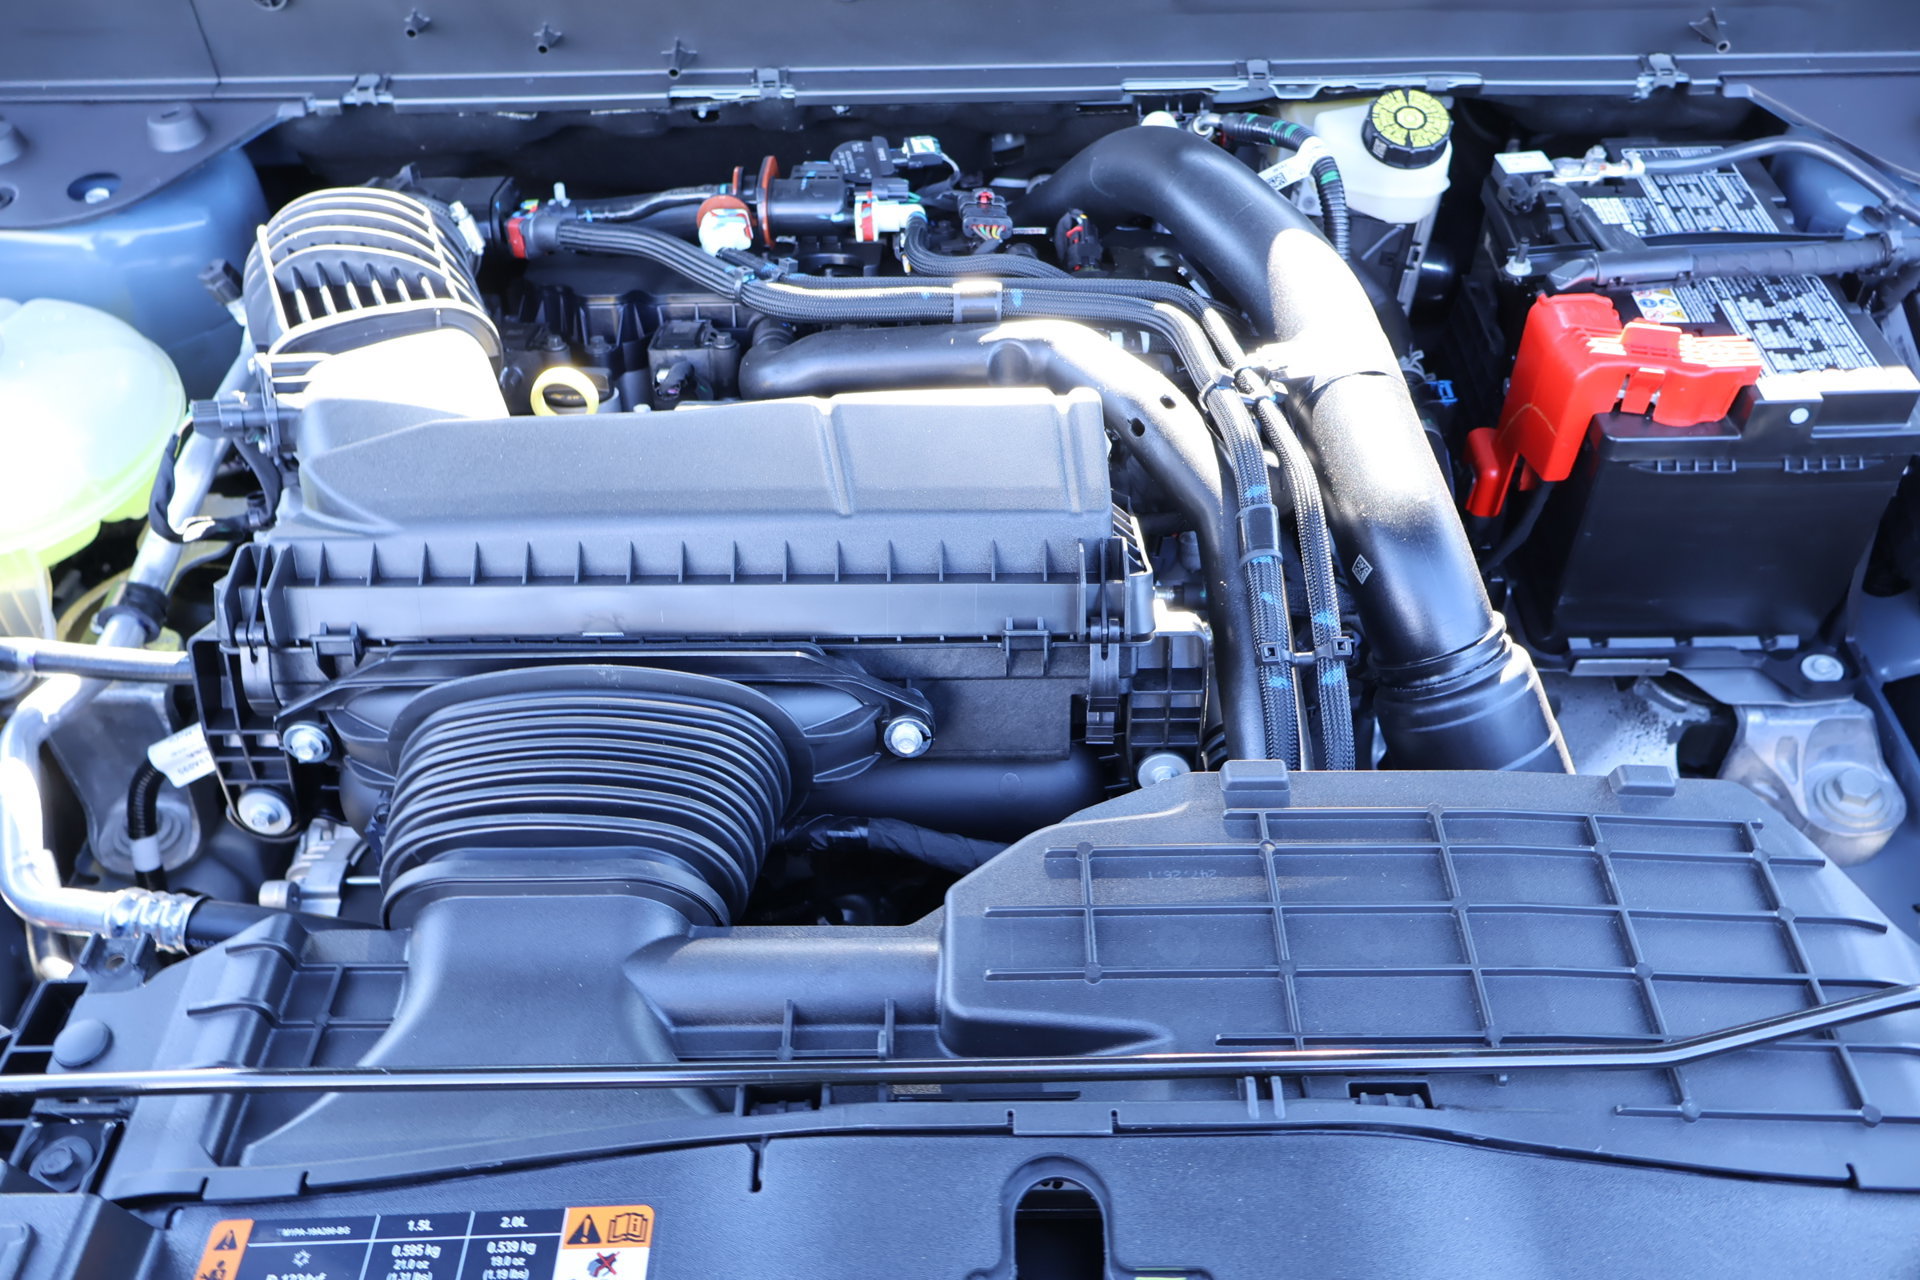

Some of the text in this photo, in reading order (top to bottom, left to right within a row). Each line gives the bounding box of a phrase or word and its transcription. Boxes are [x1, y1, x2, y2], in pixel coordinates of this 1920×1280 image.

[407, 1219, 434, 1232] 1.5L
[499, 1215, 528, 1229] 2.0L
[424, 1243, 442, 1259] kg
[520, 1240, 537, 1256] kg
[415, 1259, 430, 1270] oz
[512, 1256, 526, 1267] oz
